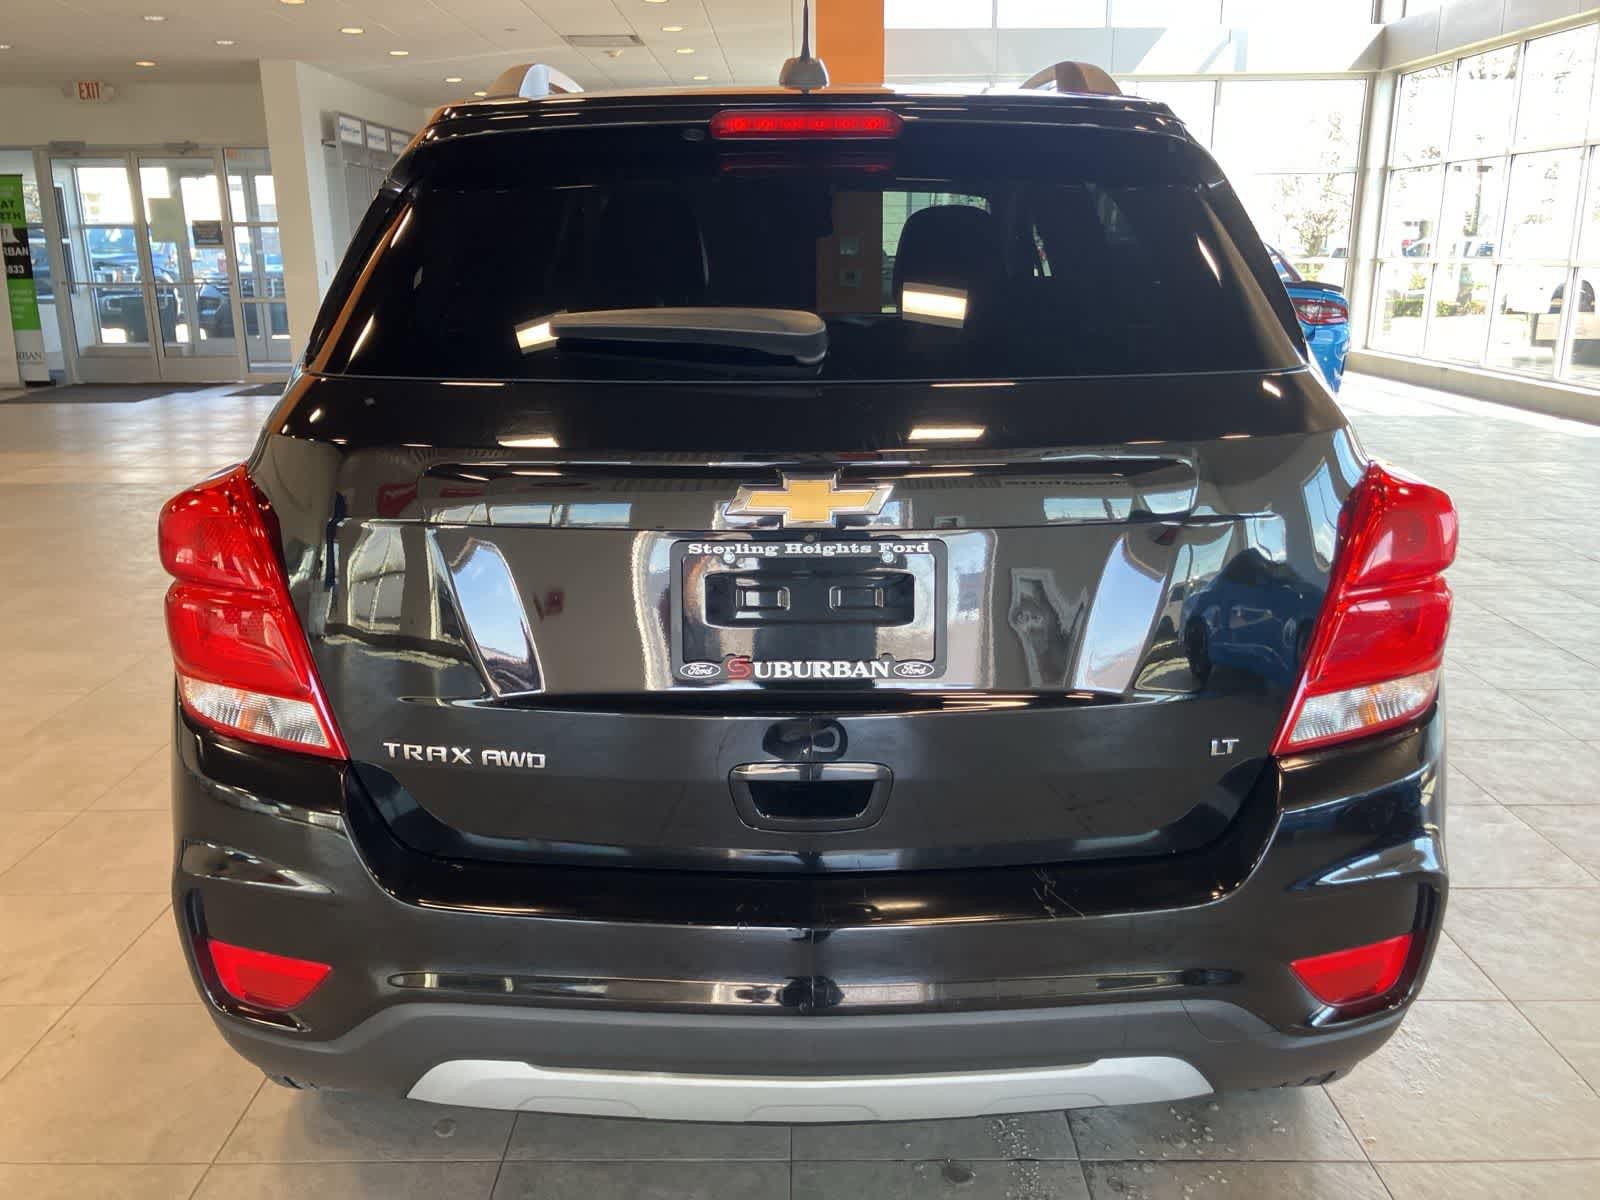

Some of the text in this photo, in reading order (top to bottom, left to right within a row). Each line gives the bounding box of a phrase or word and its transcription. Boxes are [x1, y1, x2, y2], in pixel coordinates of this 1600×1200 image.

[79, 81, 100, 101] EXIT
[688, 542, 930, 557] Sterling Heights Ford
[727, 658, 890, 679] SUBURBAN
[383, 742, 546, 769] TRAX AWD
[1210, 738, 1240, 757] LT
